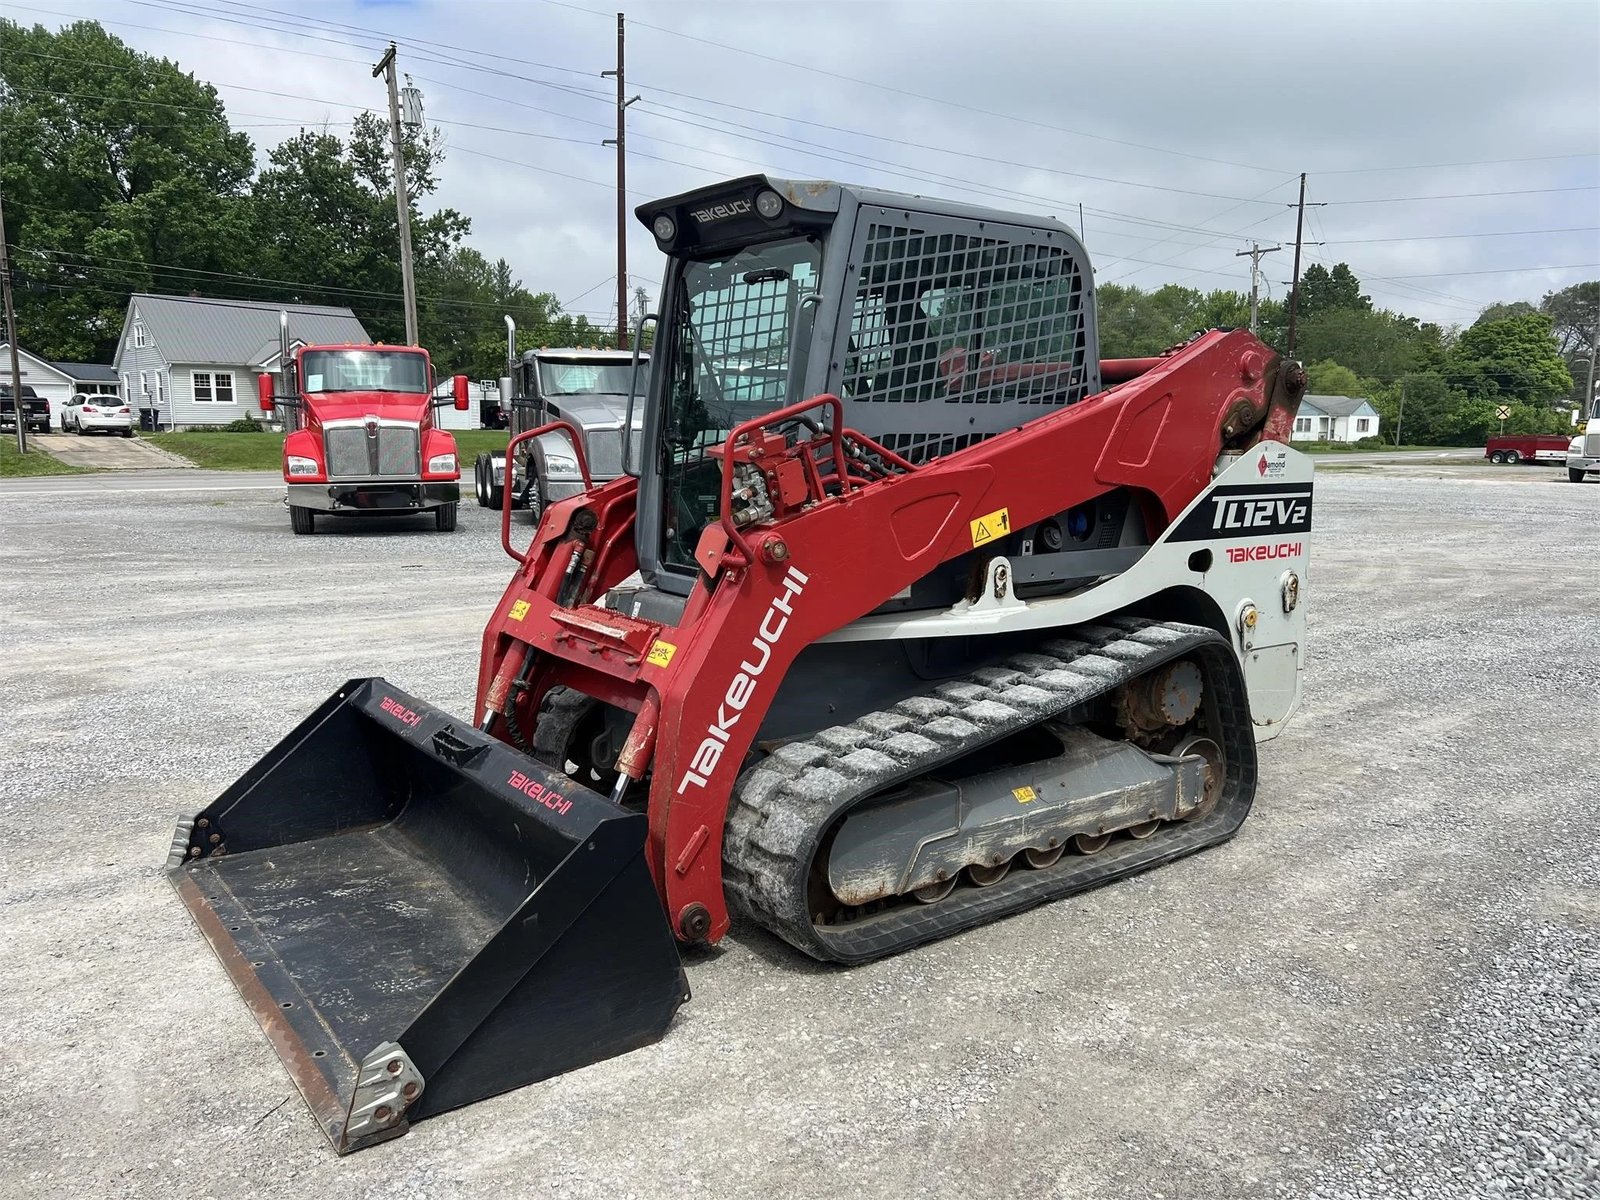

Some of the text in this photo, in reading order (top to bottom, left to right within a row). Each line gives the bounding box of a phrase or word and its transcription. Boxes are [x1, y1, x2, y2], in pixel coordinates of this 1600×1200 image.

[690, 198, 752, 223] TAKEUCH
[1225, 542, 1302, 563] TAKEUCHI
[677, 565, 810, 795] TAKEUCHI
[506, 769, 574, 816] TAKEUCHI
